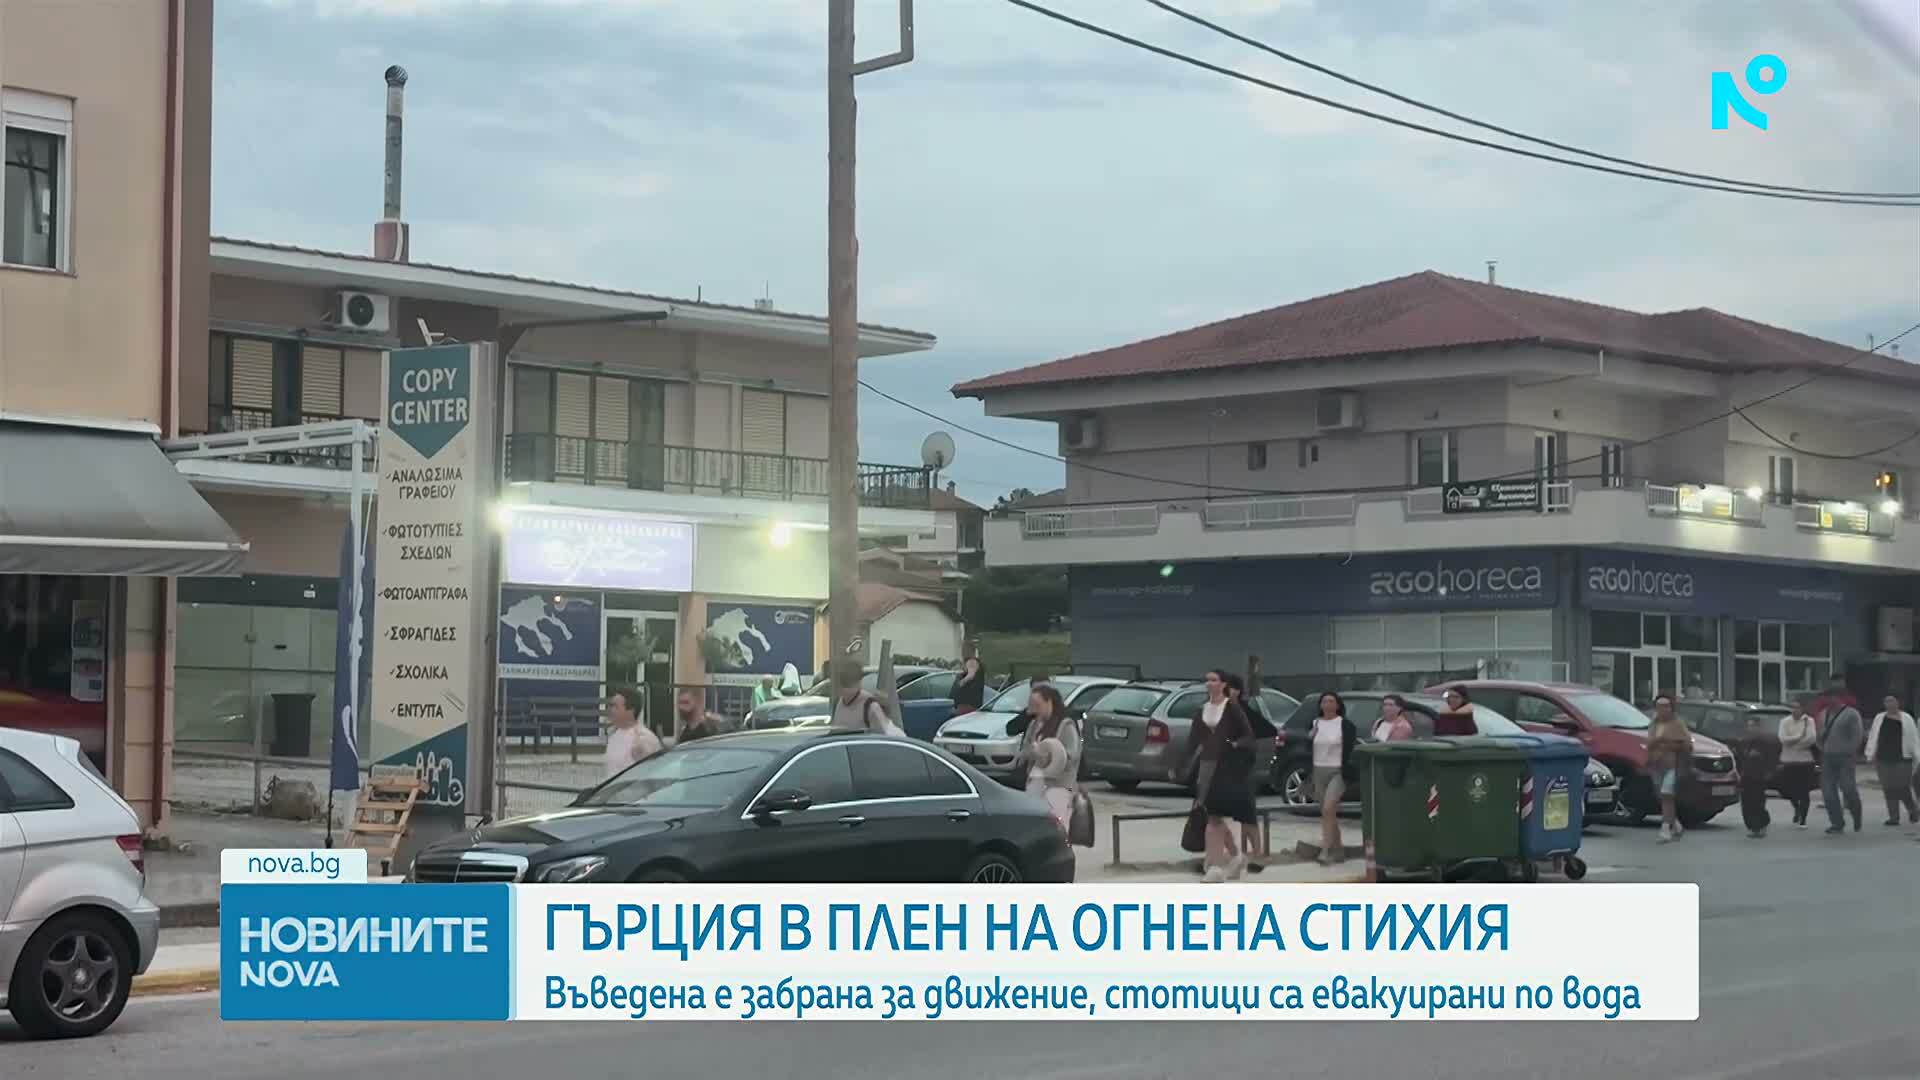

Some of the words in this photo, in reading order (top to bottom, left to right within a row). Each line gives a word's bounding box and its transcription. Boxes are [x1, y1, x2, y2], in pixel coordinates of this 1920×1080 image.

[402, 367, 457, 394] COPY
[391, 397, 468, 426] CENTER
[391, 466, 463, 483] ΑΝΑΛΩΣΙΜΑ
[399, 484, 456, 500] ΓΡΑΦΕΙΟΥ
[388, 522, 463, 539] ΦΩΤΟΤΥΠΙΕΣ
[400, 545, 452, 561] ΣΧΕΔΙΩΝ
[383, 586, 469, 601] ΦΩΤΟΑΝΤΙΓΡΑΦΑ
[389, 626, 457, 642] ΣΦΡΑΓΙΔΕΣ
[395, 664, 449, 680] ΣΧΟΛΙΚΑ
[396, 703, 444, 719] ΕΝΤΥΠΑ
